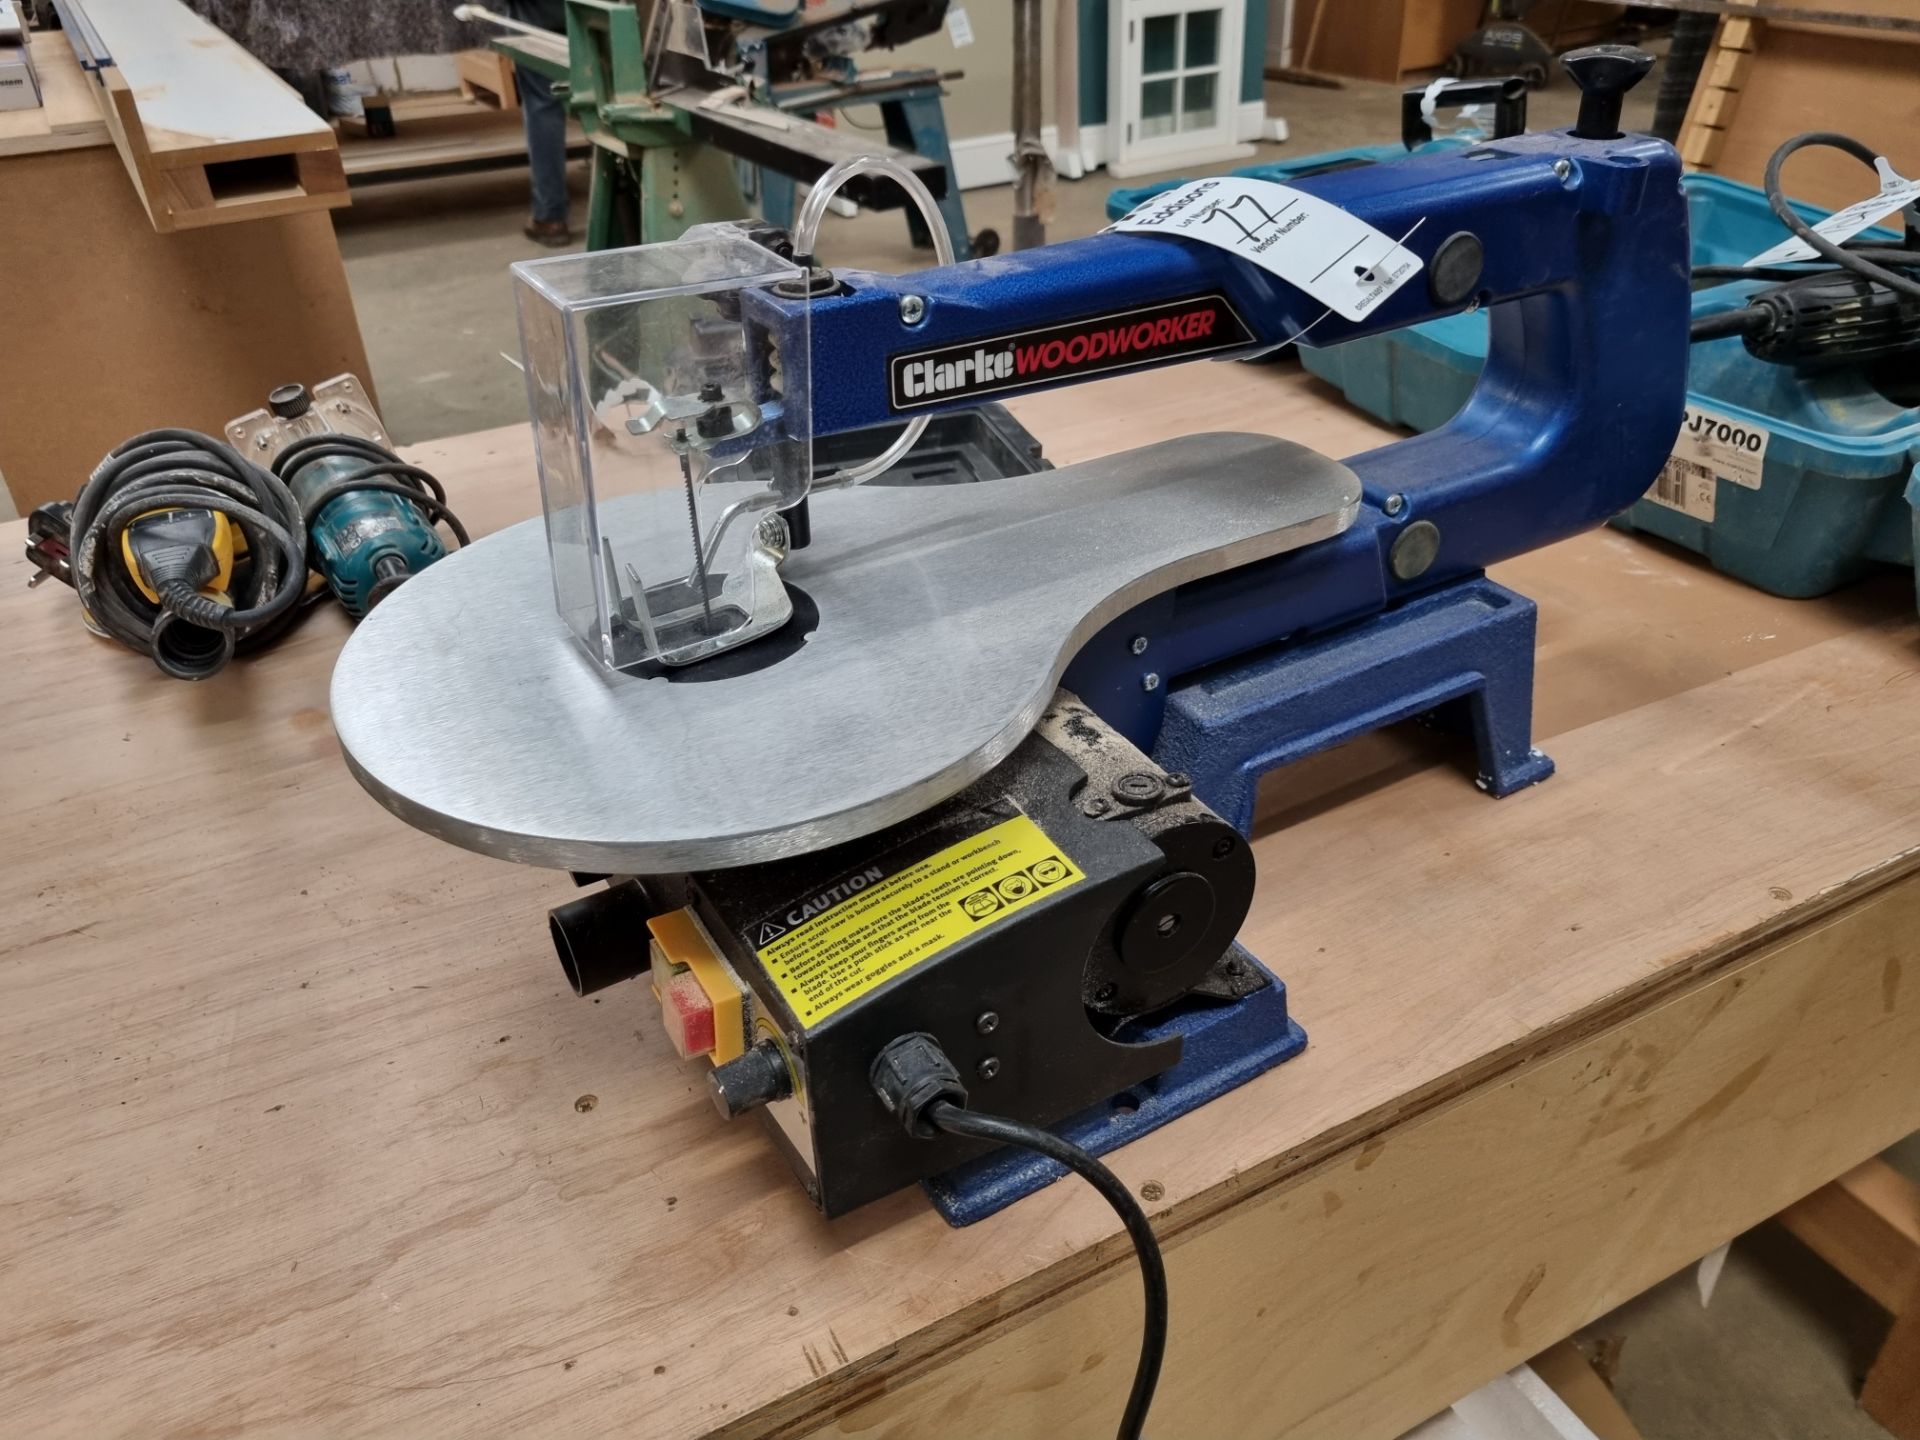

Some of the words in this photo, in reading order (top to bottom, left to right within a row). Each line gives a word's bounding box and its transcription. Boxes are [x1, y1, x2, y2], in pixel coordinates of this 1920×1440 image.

[1136, 181, 1220, 225] Eddisons
[1176, 215, 1195, 228] Lot
[1250, 232, 1280, 254] Vendor
[1275, 212, 1310, 236] Number:
[903, 348, 1014, 398] Clarke
[1014, 310, 1216, 376] WOODWORKER
[766, 936, 795, 956] Always
[795, 924, 814, 939] read
[813, 901, 858, 928] instruction
[858, 883, 889, 903] manual
[887, 871, 914, 887] before
[779, 941, 807, 959] Ensure
[807, 926, 830, 943] scroll
[830, 918, 846, 930] saw
[854, 898, 881, 916] bolted
[881, 882, 913, 902] securely
[929, 862, 951, 876] stand
[960, 839, 1001, 861] workbench
[786, 867, 883, 925] CAUTION
[789, 956, 816, 974] Before
[816, 937, 849, 958] starting
[848, 924, 870, 939] make
[870, 914, 888, 927] sure
[901, 892, 931, 909] blade's
[930, 881, 952, 894] teeth
[965, 859, 998, 878] pointing
[793, 959, 826, 980] towards
[839, 938, 862, 953] table
[862, 928, 878, 940] and
[877, 919, 895, 931] that
[908, 900, 932, 914] blade
[931, 885, 961, 902] tension
[969, 868, 998, 883] correct.
[783, 948, 810, 966] before
[799, 969, 829, 989] Always
[827, 957, 849, 971] keep
[848, 945, 867, 961] your
[867, 930, 896, 948] fingers
[896, 918, 917, 933] away
[916, 908, 937, 921] from
[803, 979, 830, 996] blade.
[829, 967, 846, 979] Use
[853, 951, 874, 967] push
[873, 940, 894, 954] stick
[903, 926, 920, 938] you
[920, 916, 938, 928] near
[808, 989, 825, 1002] end
[833, 976, 849, 987] the
[848, 967, 865, 978] cut.
[814, 991, 844, 1012] Always
[843, 978, 864, 993] wear
[864, 959, 897, 982] goggles
[897, 948, 914, 962] and
[920, 934, 945, 949] mask.
